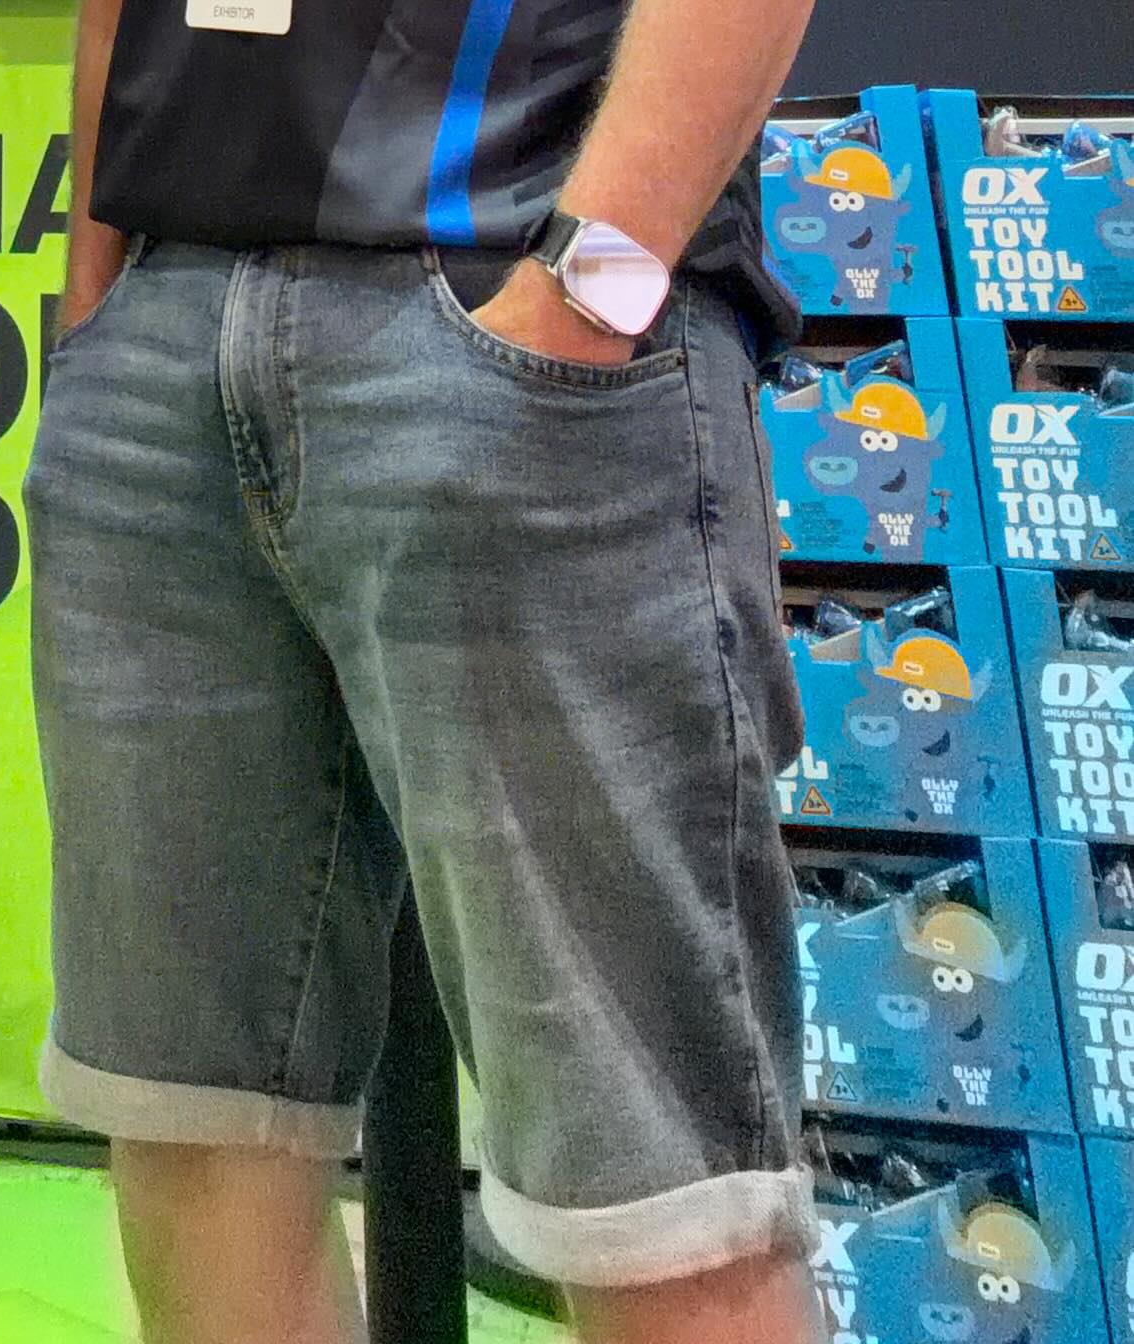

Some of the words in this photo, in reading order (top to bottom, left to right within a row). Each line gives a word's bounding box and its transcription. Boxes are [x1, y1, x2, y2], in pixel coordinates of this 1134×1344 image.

[213, 5, 256, 21] EXHIBITOR
[962, 167, 1049, 205] OX
[964, 218, 1048, 248] TOY
[845, 268, 880, 279] OLLY
[969, 249, 1084, 281] TOOL
[851, 278, 877, 289] THE
[975, 282, 1054, 313] KIT
[990, 403, 1081, 445] OX
[992, 457, 1079, 491] TOY
[877, 512, 914, 525] OLLY
[997, 492, 1118, 528] TOOL
[884, 524, 912, 535] THE
[1004, 526, 1086, 561] KIT
[1040, 663, 1134, 710] OX
[1044, 720, 1134, 760] TOY
[921, 778, 959, 791] OLLY
[927, 790, 956, 803] THE
[933, 802, 953, 815] OX
[1056, 795, 1134, 835] KIT
[953, 1065, 992, 1081] OLLY
[965, 1091, 986, 1106] OX
